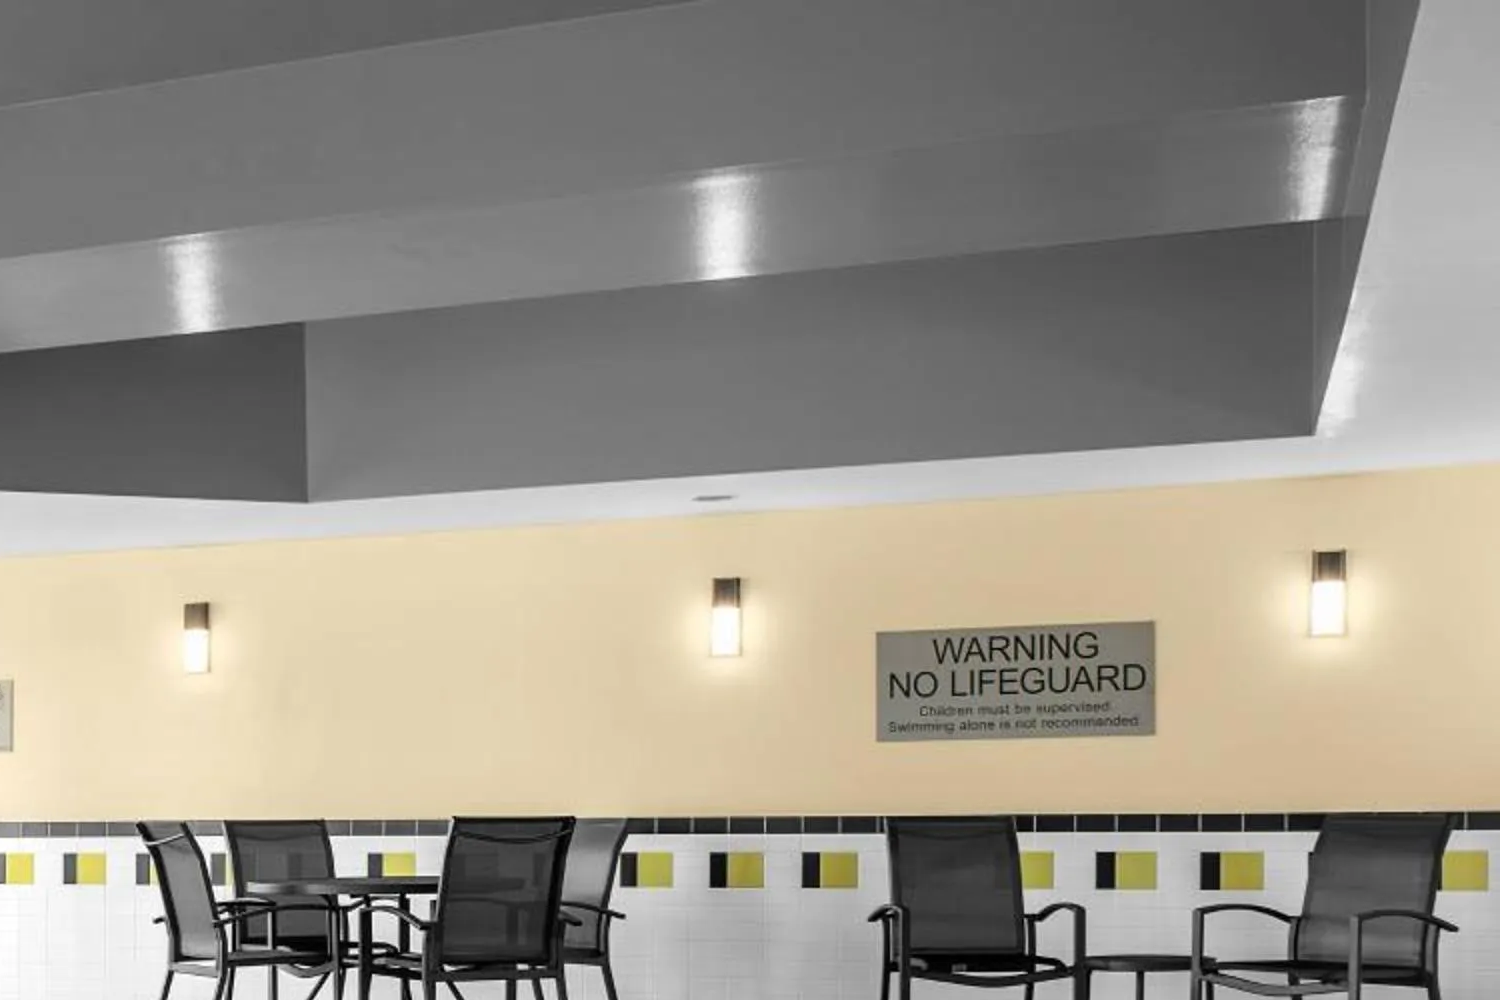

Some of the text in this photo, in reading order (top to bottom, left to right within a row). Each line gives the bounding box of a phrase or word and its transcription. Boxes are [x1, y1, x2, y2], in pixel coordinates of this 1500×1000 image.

[932, 631, 1099, 665] WARNING
[889, 663, 1146, 698] NO LIFEGUARD
[919, 701, 1110, 717] Children must be supervised
[889, 721, 955, 734] Swimming
[959, 720, 995, 731] alone
[999, 720, 1011, 730] is
[1015, 718, 1037, 729] not
